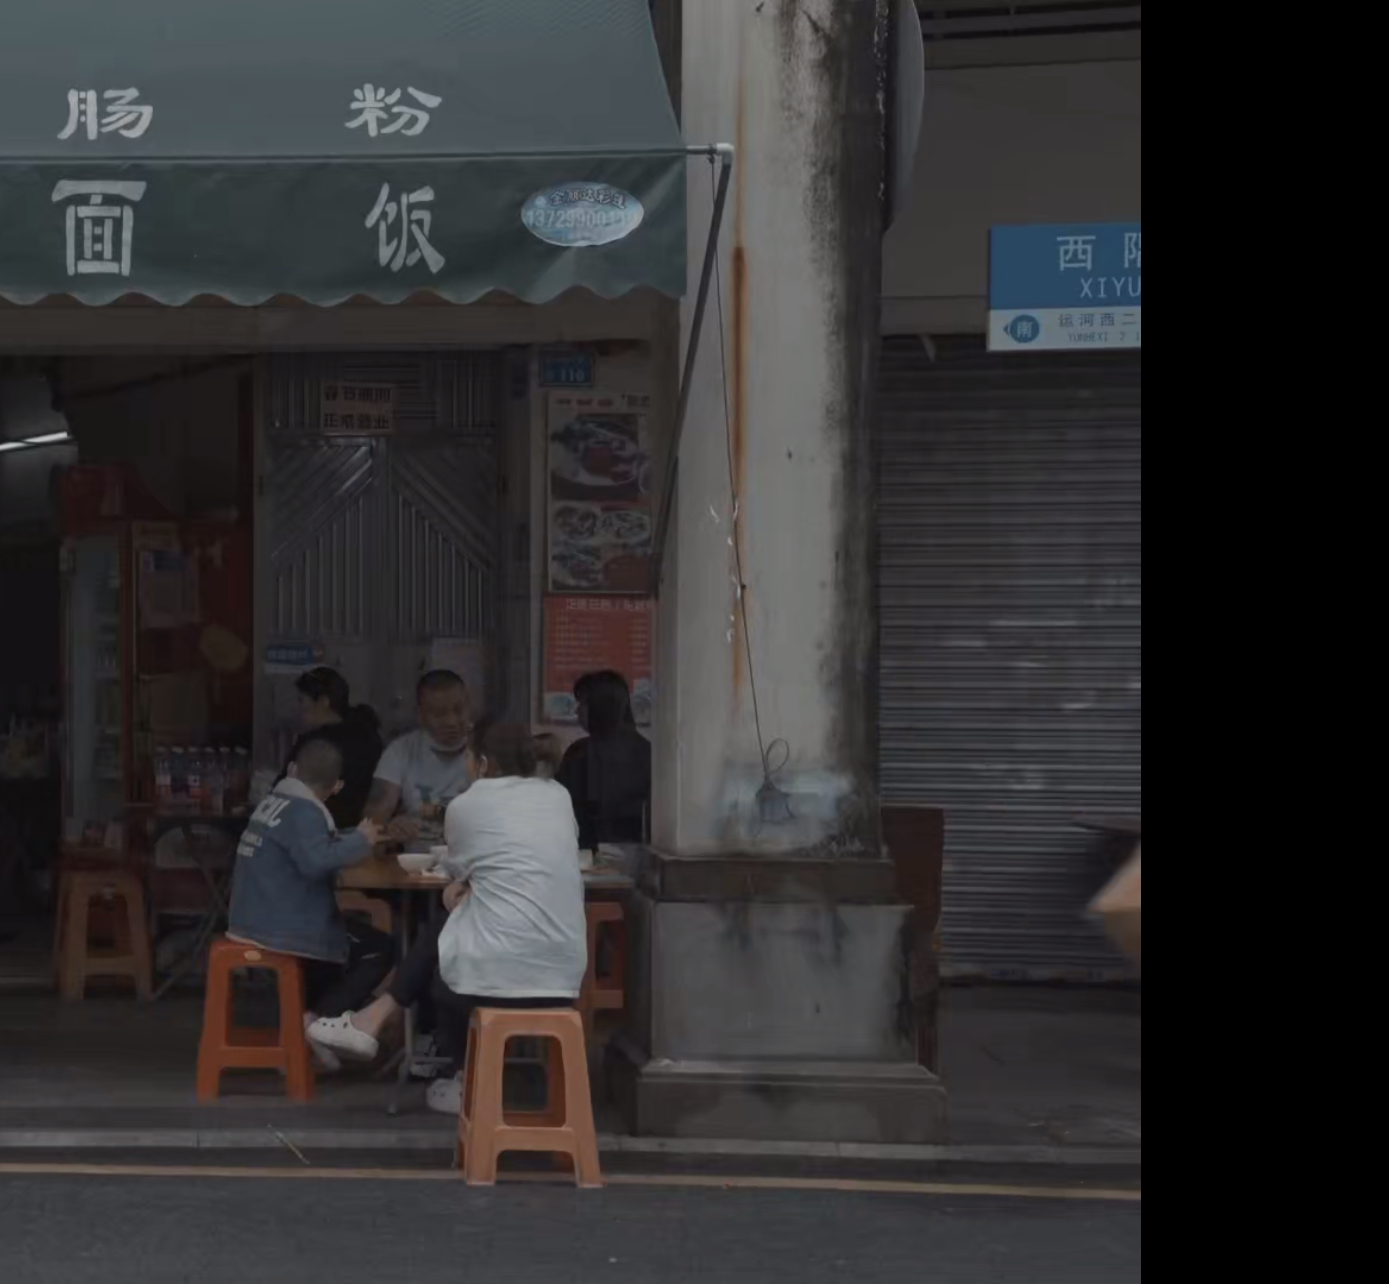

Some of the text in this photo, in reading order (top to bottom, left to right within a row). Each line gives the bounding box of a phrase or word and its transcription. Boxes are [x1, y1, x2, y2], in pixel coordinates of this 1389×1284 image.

[1080, 275, 1141, 299] XIYU
[1016, 320, 1034, 338] 南
[1058, 313, 1136, 328] 运河西二
